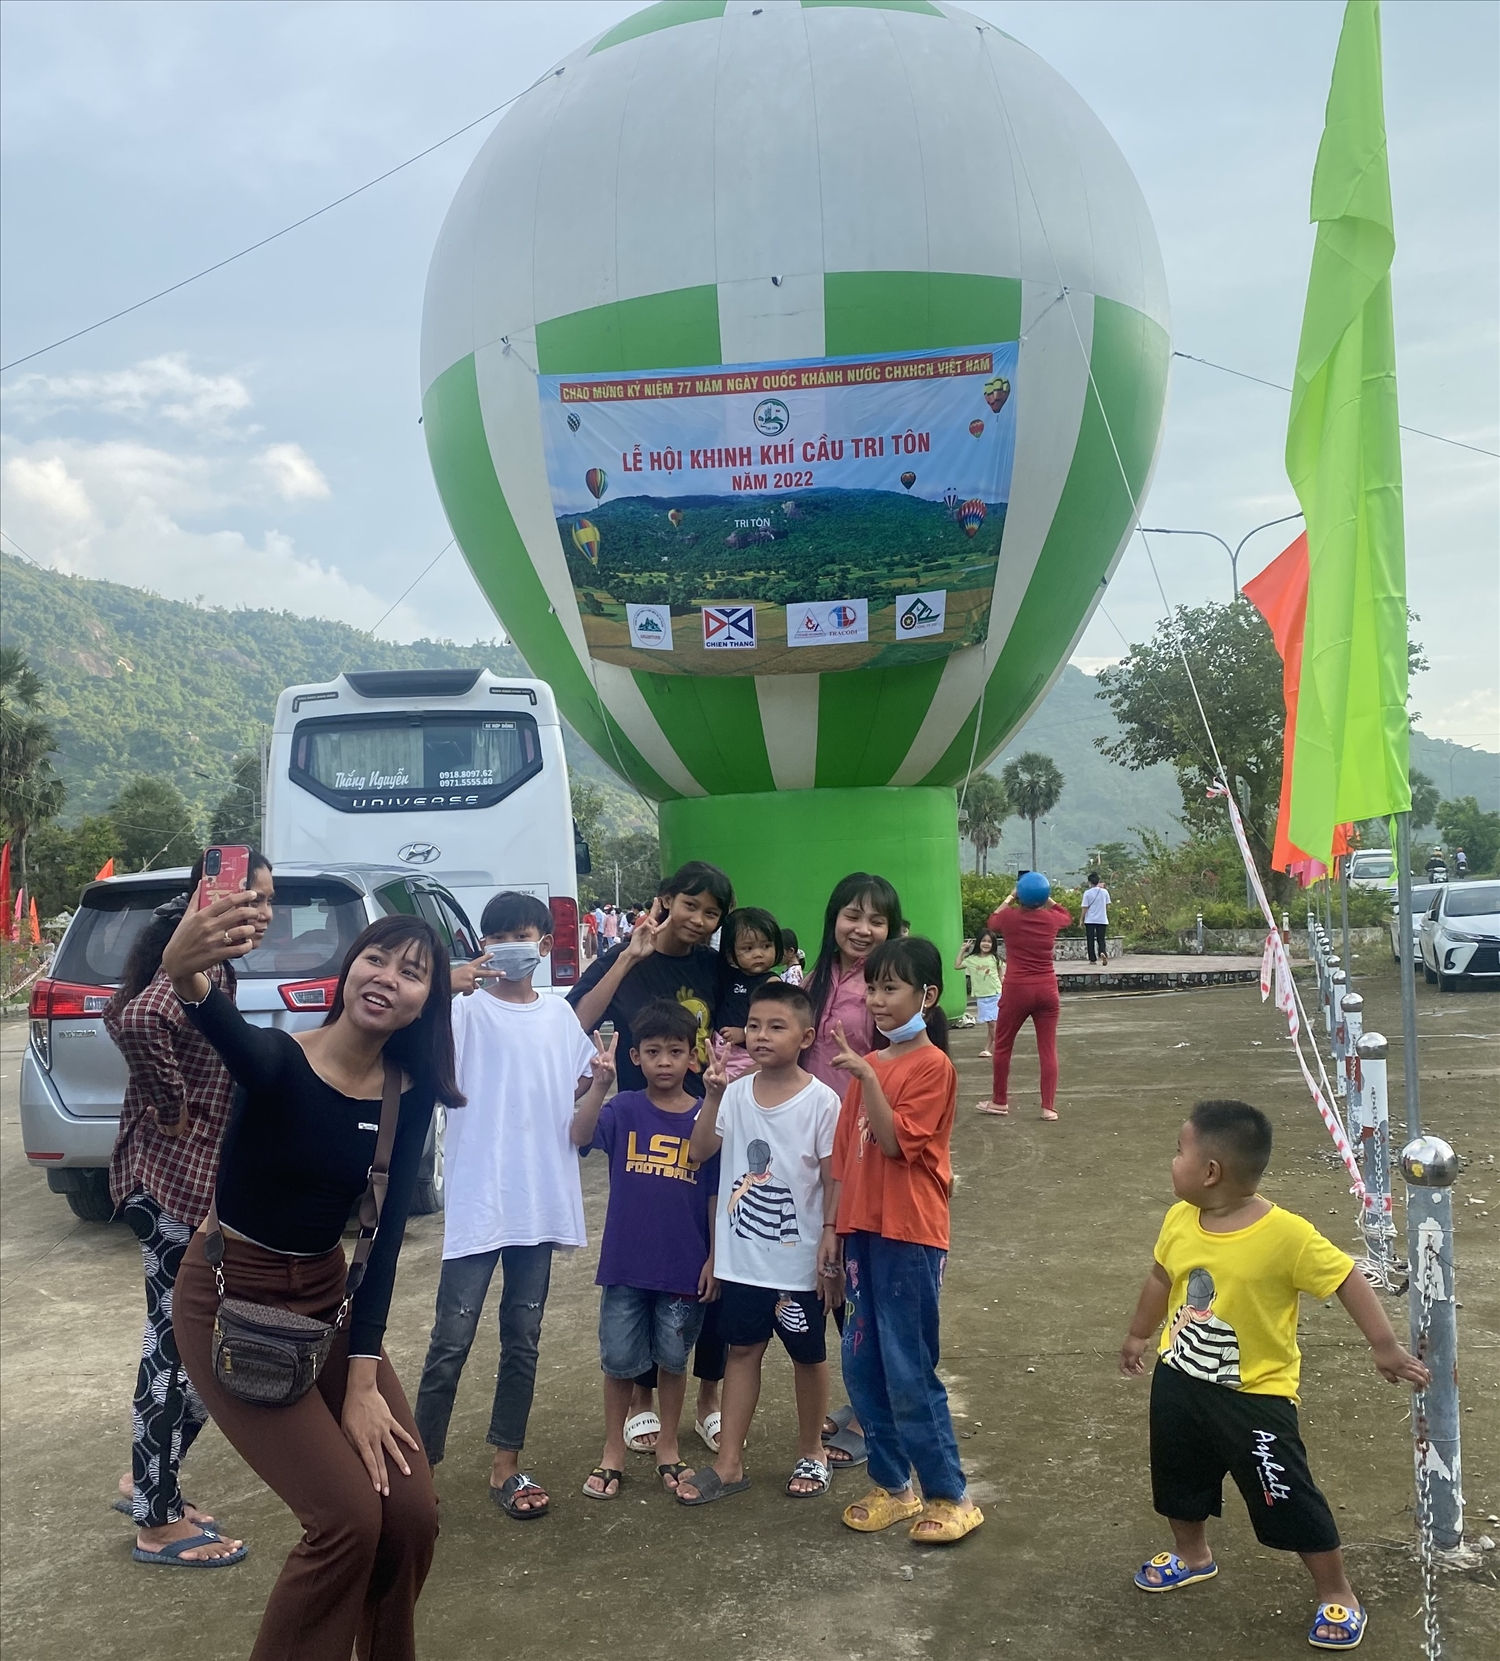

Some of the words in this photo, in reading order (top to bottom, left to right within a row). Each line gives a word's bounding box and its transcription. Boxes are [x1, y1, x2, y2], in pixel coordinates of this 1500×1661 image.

[593, 383, 624, 399] MỪNG
[627, 380, 641, 397] KỶ
[644, 381, 673, 399] NIỆM
[677, 381, 692, 395] 77
[695, 377, 723, 394] NĂM
[726, 375, 759, 391] NGÀY
[762, 370, 797, 389] QUỐC
[801, 368, 843, 386] KHÁNH
[847, 366, 881, 382] NƯỚC
[885, 363, 934, 379] CHXHCN
[937, 359, 962, 377] VIỆT
[965, 358, 990, 373] NAM
[622, 444, 643, 472] LỄ
[650, 446, 682, 475] HỘI
[690, 446, 752, 470] KHINH
[760, 438, 795, 466] KHÍ
[802, 434, 844, 462] CẦU
[851, 436, 884, 459] TRI
[891, 428, 930, 455] TÔN
[732, 472, 768, 491] NĂM
[773, 471, 813, 489] 2022
[734, 519, 749, 528] TRI
[750, 517, 771, 527] TÔN
[730, 640, 755, 648] THANG
[335, 769, 365, 790] Thắng
[368, 768, 409, 790] Nguyễn
[439, 769, 493, 779] 0918.8097.62
[439, 777, 493, 787] 0971.5555.60
[353, 795, 479, 808] UNIVERSE
[625, 1160, 698, 1185] FOOTBALL
[1251, 1429, 1291, 1500] Asphalt
